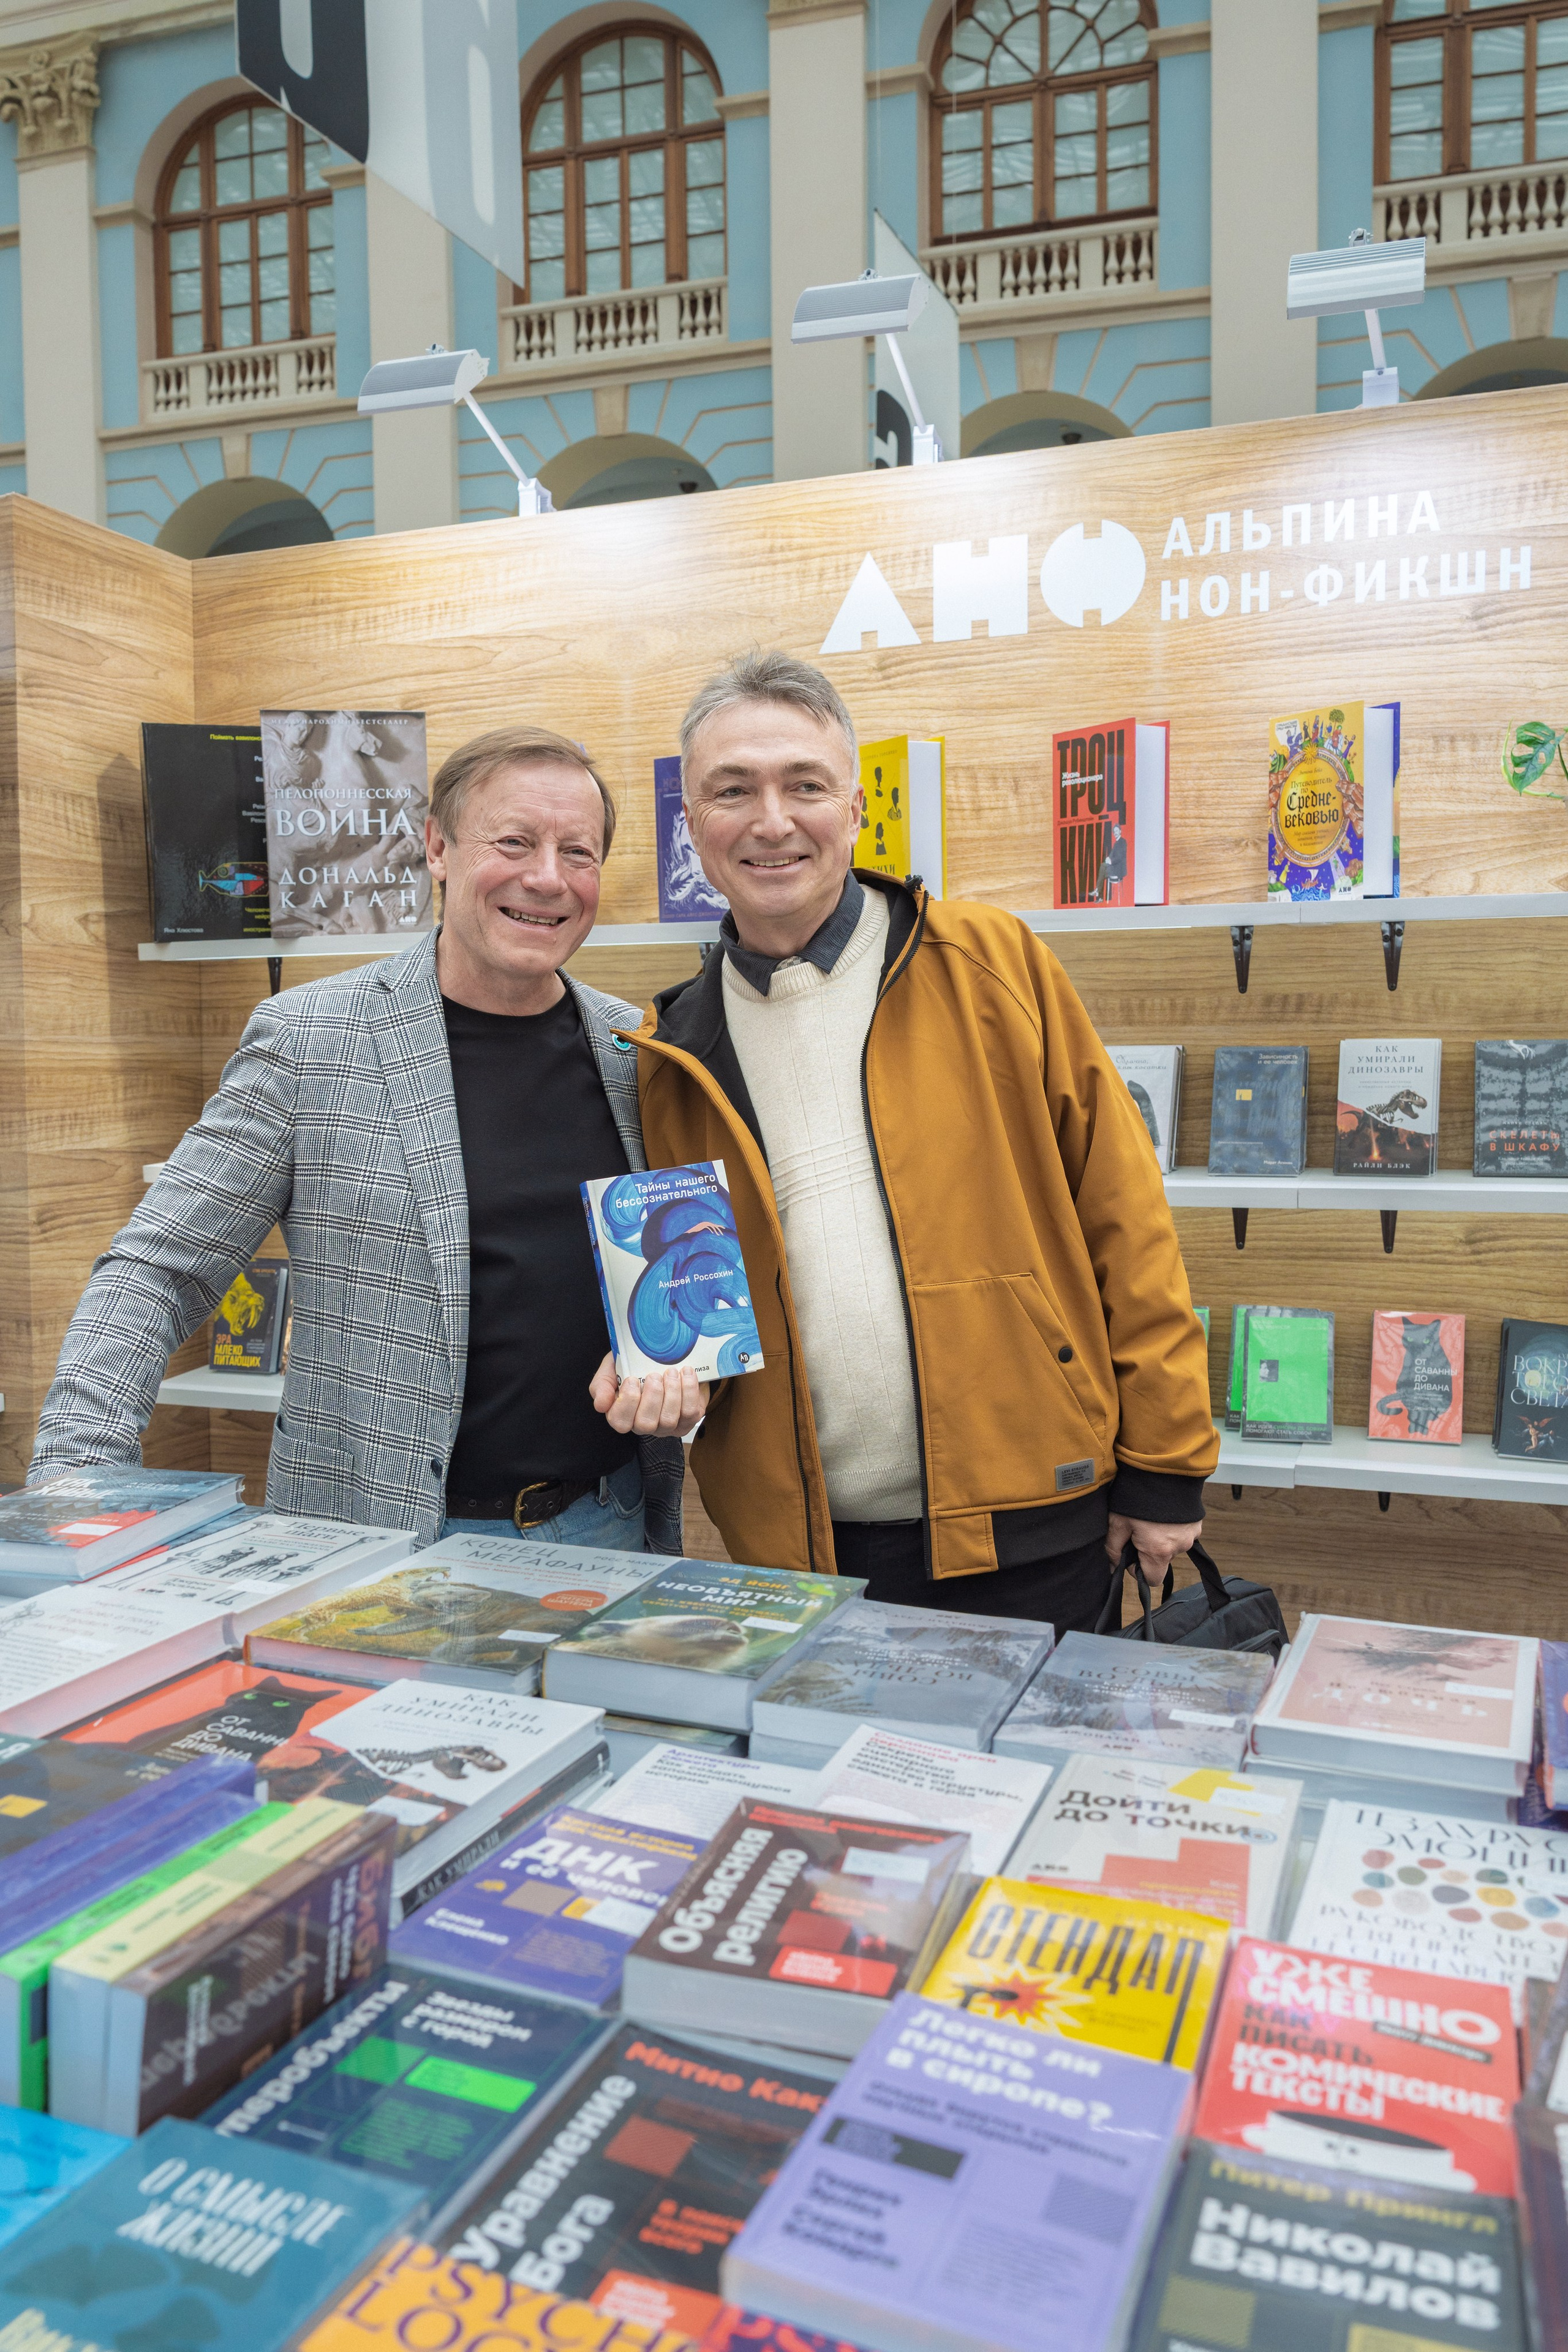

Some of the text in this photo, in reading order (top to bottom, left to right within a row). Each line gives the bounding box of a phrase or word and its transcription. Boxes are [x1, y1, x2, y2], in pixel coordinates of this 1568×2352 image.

[1160, 490, 1441, 559] АЛЬПИНА
[1160, 545, 1532, 622] НОН-ФИКШН
[1057, 729, 1127, 826] ТРОЦ
[1061, 771, 1080, 780] Жизнь
[1291, 777, 1332, 790] Путеводитель
[274, 788, 413, 800] ПЕЛОПОННЕССКАЯ
[1286, 790, 1336, 812] Средне-
[276, 802, 417, 837] ВОЙНА
[1284, 807, 1340, 829] вековью
[278, 866, 418, 886] ДОНАЛЬД
[280, 889, 417, 909] КАГАН
[1348, 1066, 1424, 1075] ДИНОЗАВРЫ
[1357, 1055, 1416, 1064] УМИРАЛИ
[1489, 1131, 1561, 1140] СКЕЛЕТЫ
[1490, 1143, 1561, 1152] В ШКАФУ
[635, 1174, 716, 1194] Тайны нашего
[615, 1184, 718, 1209] бессознательного
[658, 1269, 734, 1289] Андрей Россохин
[214, 1344, 244, 1355] МЛЕКО
[216, 1333, 232, 1344] ЭРА
[213, 1354, 262, 1368] ПИТАЮЩИХ
[1414, 1366, 1458, 1376] САВАННЫ
[1413, 1382, 1450, 1392] ДИВАНА
[48, 1477, 105, 1488] КАК
[284, 1529, 338, 1540] шаги
[287, 1521, 366, 1537] Первые
[459, 1538, 559, 1558] КОНЕЦ
[467, 1550, 654, 1579] МЕГАФАУНЫ
[626, 1559, 667, 1567] МАКФИ
[656, 1581, 823, 1609] НЕОБЪЯТНЫЙ
[718, 1577, 742, 1585] ЭД
[746, 1578, 791, 1590] ЙОНГ
[546, 1597, 593, 1608] ШАУТЕНА
[556, 1594, 594, 1604] ПИТЕРА
[700, 1594, 758, 1607] МИР
[1077, 1669, 1116, 1680] ВО
[1112, 1665, 1196, 1683] СОВЫ
[410, 1697, 540, 1723] УМИРАЛИ
[463, 1693, 517, 1708] КАК
[219, 1715, 252, 1726] ОТ
[371, 1703, 545, 1736] ДИНОЗАВРЫ
[186, 1729, 224, 1744] ДО
[874, 1732, 998, 1764] Создание арки
[170, 1738, 254, 1763] ДИВАНА
[666, 1748, 761, 1770] Архитектура
[861, 1746, 956, 1775] сценарного
[865, 1741, 935, 1763] Секреты
[869, 1736, 959, 1763] персонажа
[657, 1758, 747, 1780] Как создать
[662, 1754, 718, 1769] сюжета
[644, 1770, 709, 1786] историю
[650, 1764, 792, 1793] запоминающуюся
[846, 1763, 909, 1785] сюжета
[929, 1785, 976, 1798] героя
[851, 1757, 1023, 1803] единство структуры,
[1059, 1789, 1191, 1815] Дойти
[1054, 1807, 1109, 1823] до
[499, 1858, 520, 1871] и
[511, 1836, 660, 1885] ДНК
[658, 1826, 774, 1954] Объясняя
[712, 1848, 809, 1967] религию
[1251, 1947, 1374, 1995] УЖЕ
[967, 1904, 1205, 2063] СТЕНДАП
[1242, 2003, 1312, 2031] КАК
[1247, 1975, 1502, 2046] СМЕШНО
[401, 2014, 495, 2049] с город
[411, 2002, 533, 2043] размером
[897, 2028, 1035, 2083] плыть
[908, 2008, 1103, 2081] Легко ли
[1237, 2024, 1374, 2068] ПИСАТЬ
[624, 2041, 745, 2094] Митио
[884, 2046, 1115, 2127] в сиропе?
[1229, 2065, 1385, 2121] ТЕКСТЫ
[1230, 2041, 1509, 2124] КОМИЧЕСКИЕ
[137, 2156, 189, 2195] О
[448, 2074, 637, 2270] Уравнение
[1209, 2158, 1499, 2236] Питер Прингл
[508, 2193, 615, 2293] Бога
[1199, 2197, 1502, 2295] Николай
[1190, 2231, 1502, 2331] Вавилов
